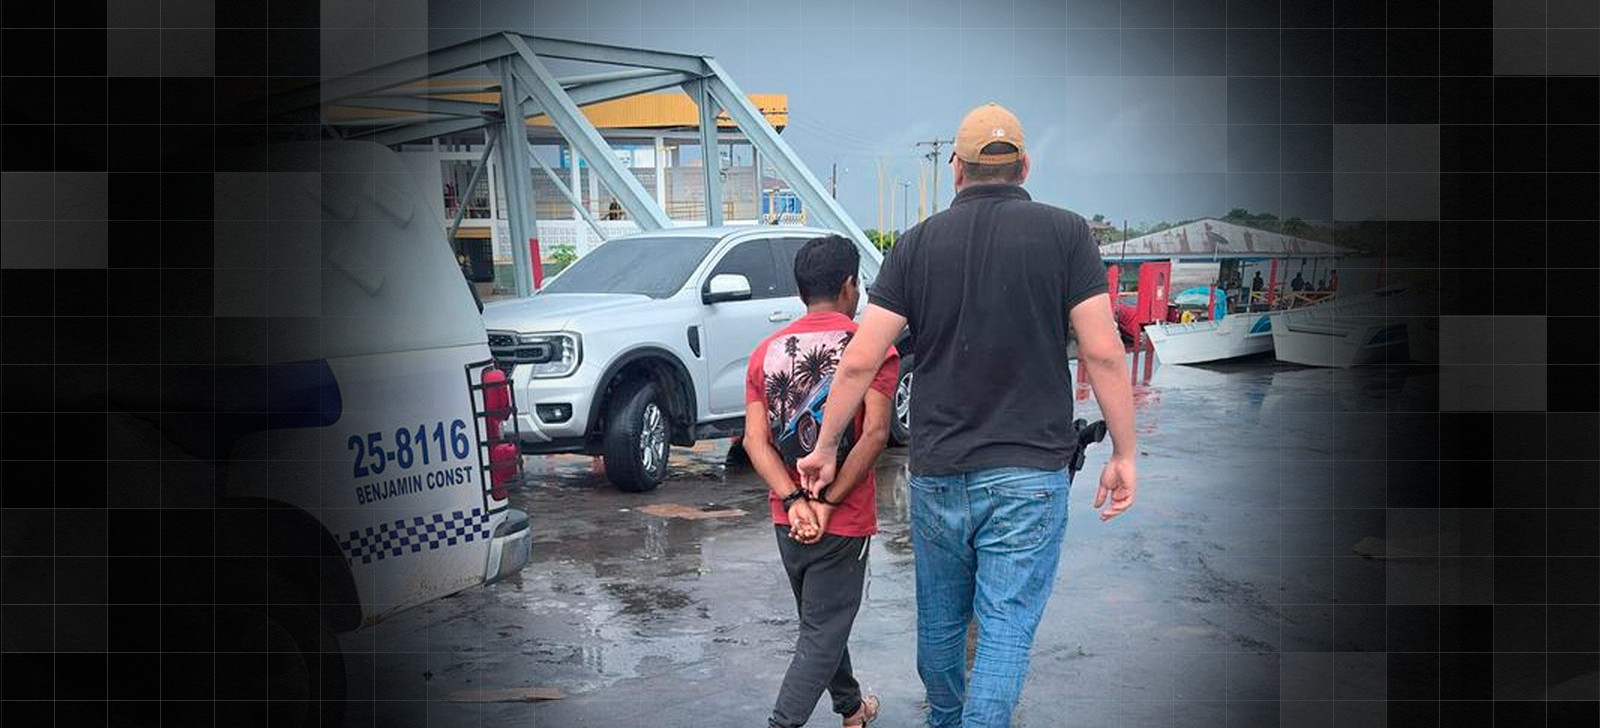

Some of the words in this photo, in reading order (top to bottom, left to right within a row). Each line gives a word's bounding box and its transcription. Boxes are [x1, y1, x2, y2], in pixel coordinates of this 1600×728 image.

[348, 419, 470, 478] 25-8116
[356, 474, 422, 505] BENJAMIN
[426, 466, 472, 490] CONST
